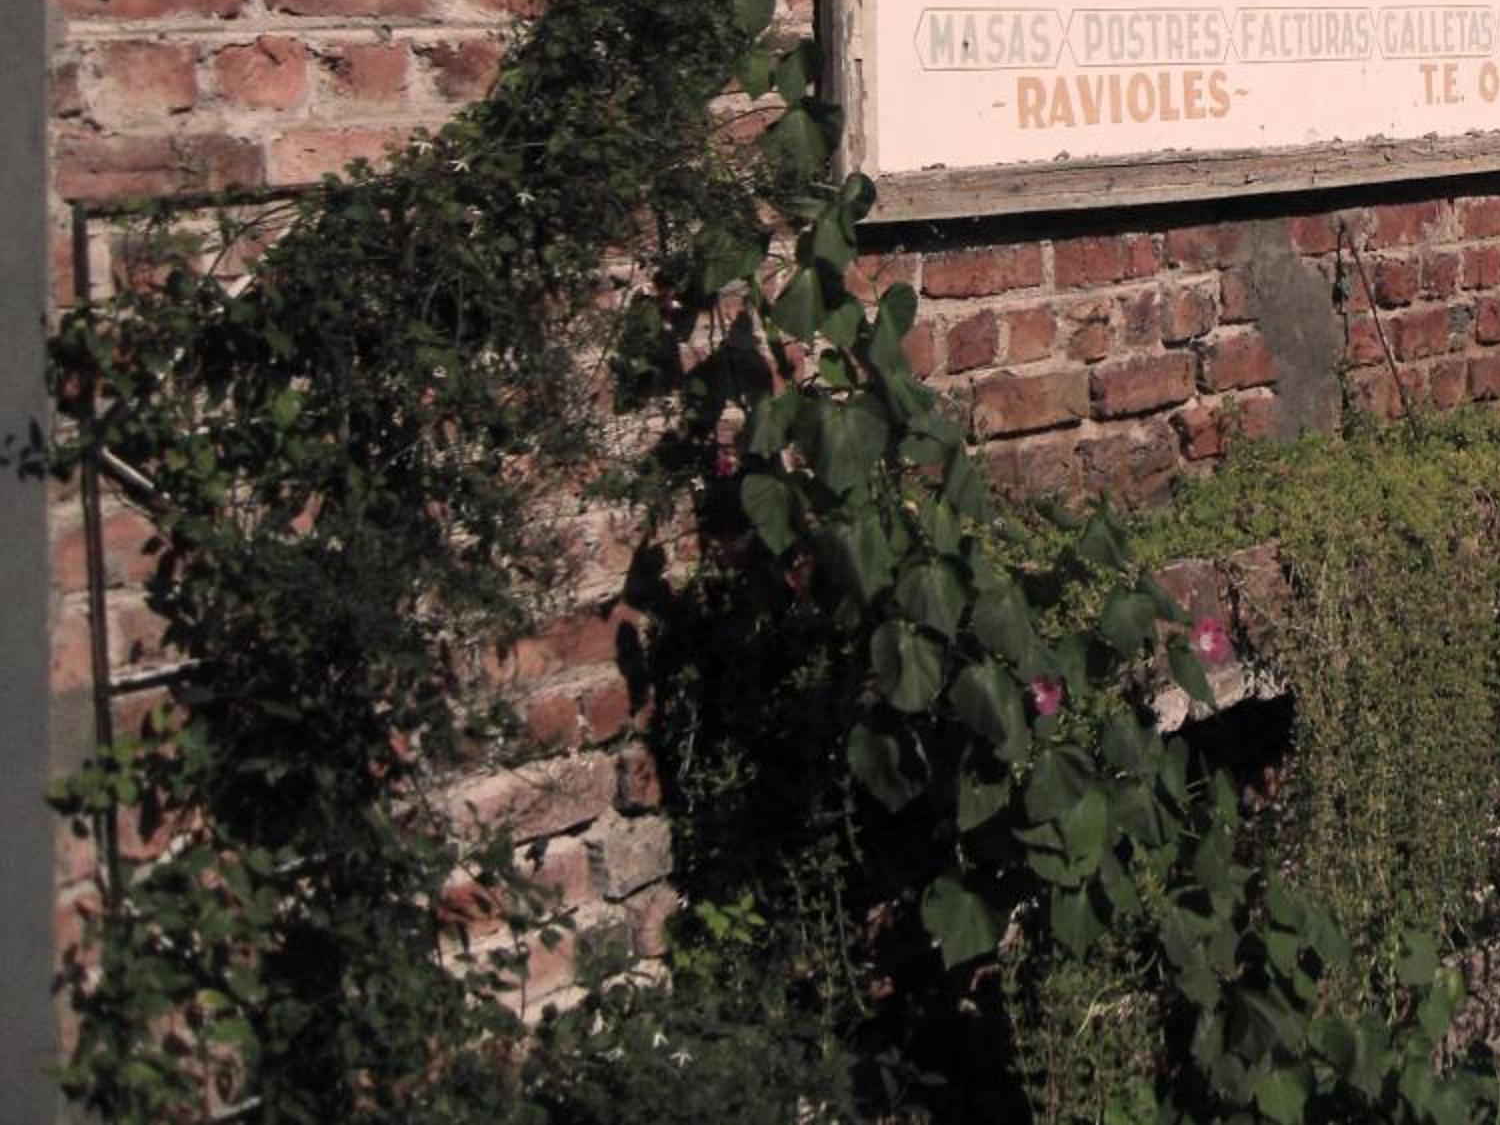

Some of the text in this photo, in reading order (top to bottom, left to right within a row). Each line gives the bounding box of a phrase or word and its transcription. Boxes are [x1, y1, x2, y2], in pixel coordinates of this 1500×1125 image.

[929, 13, 1051, 64] MASAS
[1083, 12, 1222, 61] POSTRES
[1241, 11, 1371, 58] FACTURAS
[1384, 9, 1493, 54] GALLETAS
